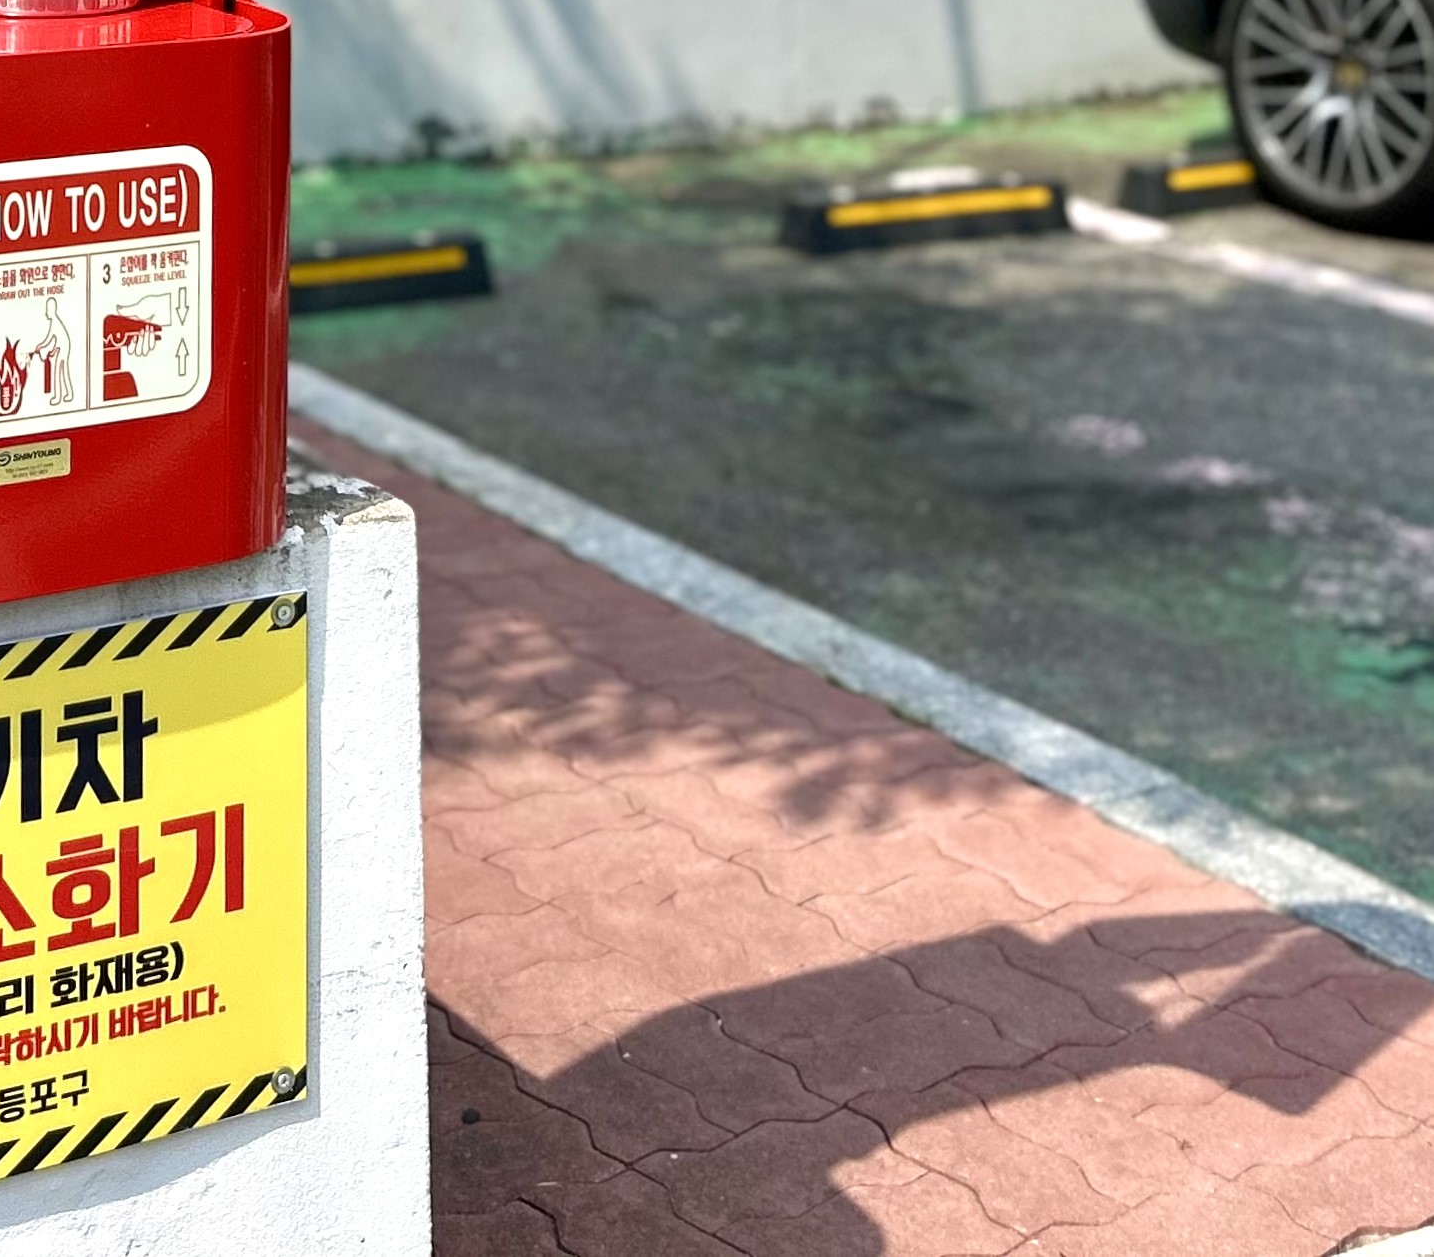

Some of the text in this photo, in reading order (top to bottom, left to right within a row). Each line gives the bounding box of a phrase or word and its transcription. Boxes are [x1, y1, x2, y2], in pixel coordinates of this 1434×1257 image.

[65, 183, 106, 233] TO
[118, 169, 188, 229] USE)
[102, 263, 111, 285] 3
[121, 273, 152, 287] SQUEEZE
[154, 271, 166, 283] THE
[18, 288, 31, 299] OUT
[33, 287, 45, 297] THE
[13, 447, 62, 462] SHINYOUNG
[50, 941, 184, 1004] 화재용)
[108, 984, 227, 1039] 바랍니다.
